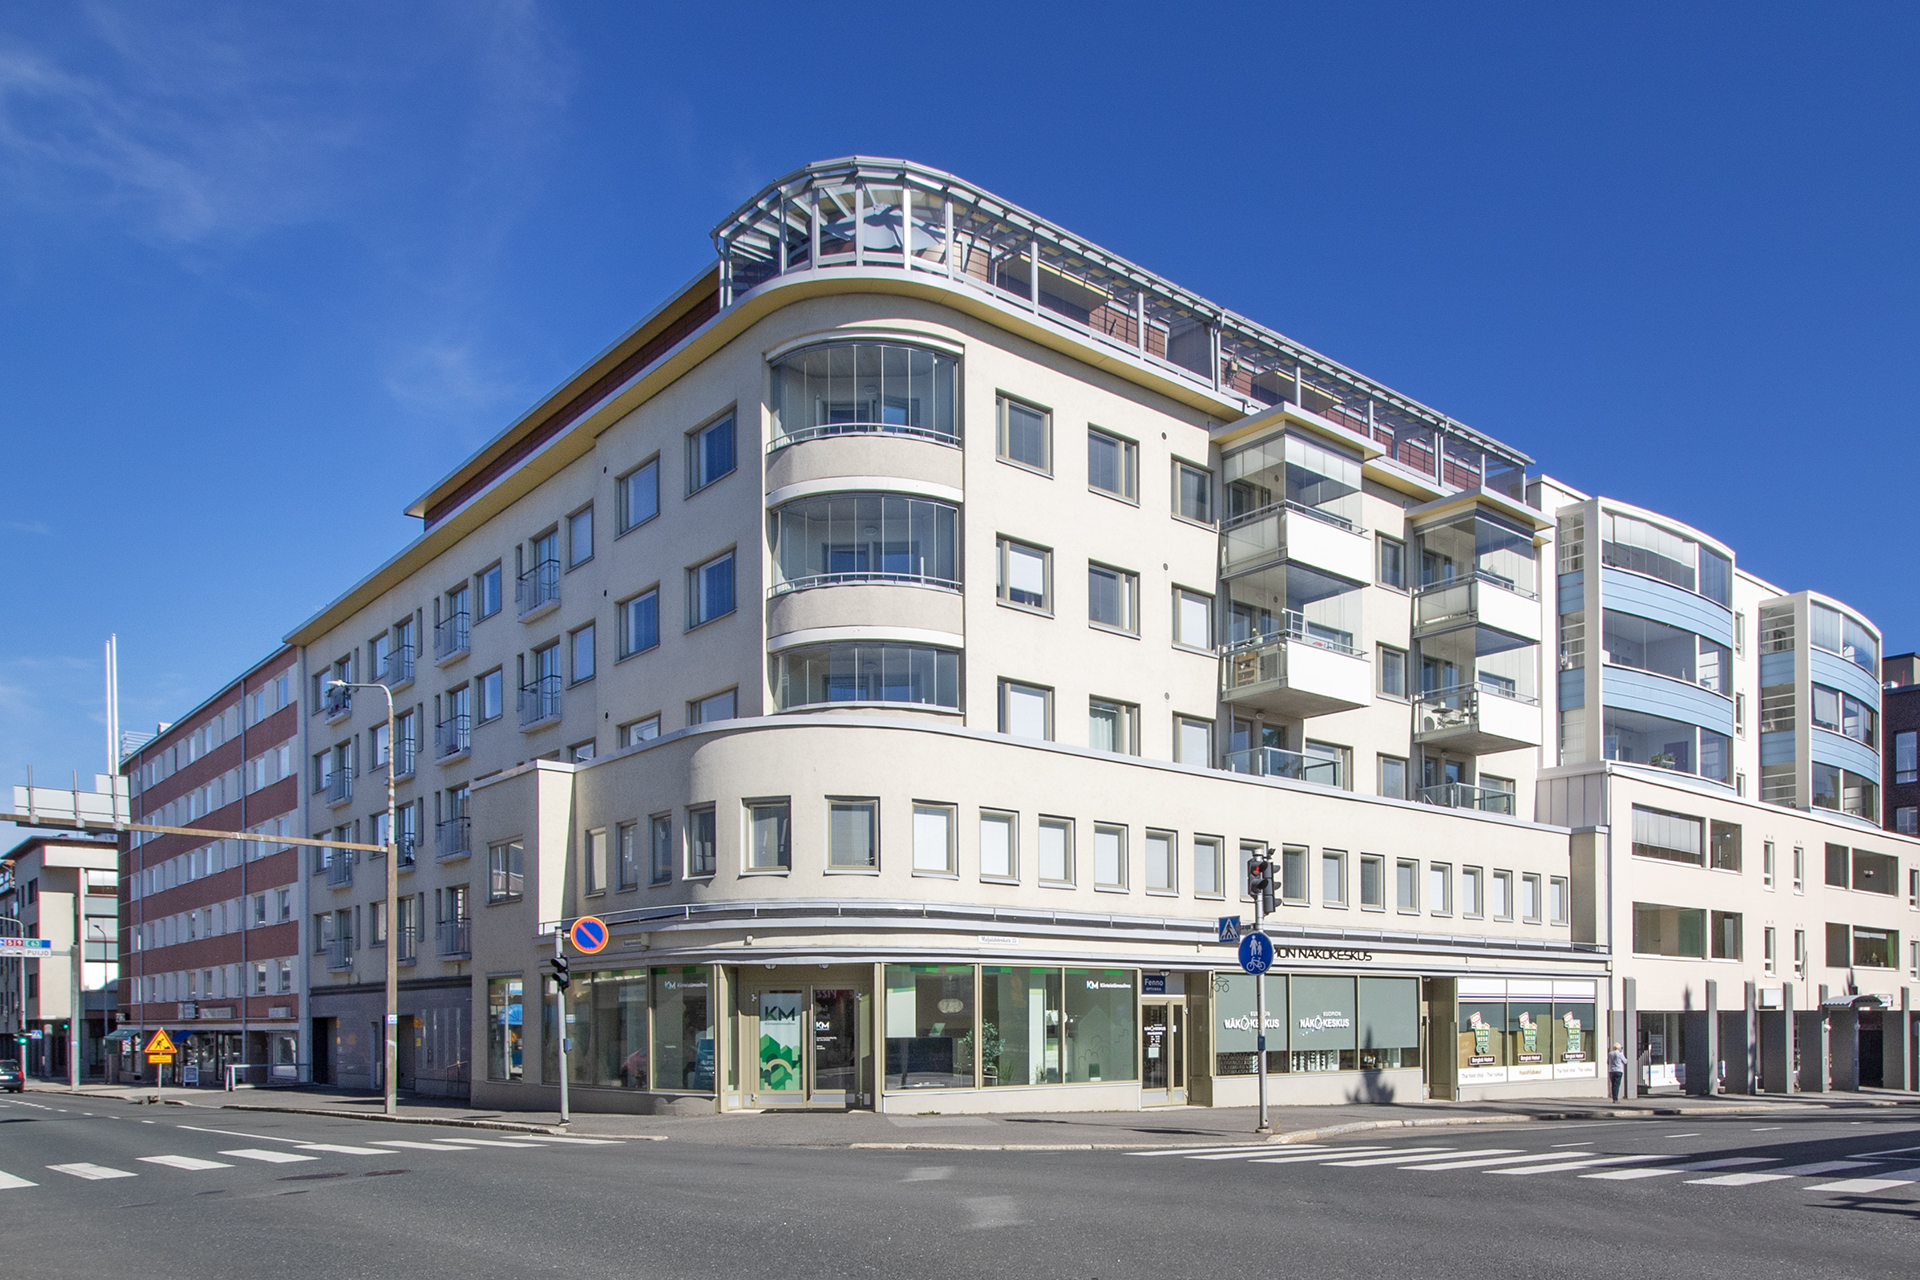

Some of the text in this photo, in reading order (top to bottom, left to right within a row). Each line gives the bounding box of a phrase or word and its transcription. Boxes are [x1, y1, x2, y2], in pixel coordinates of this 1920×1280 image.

[664, 981, 676, 989] KM
[1086, 980, 1099, 989] KM
[1144, 978, 1164, 986] Fenno
[765, 1006, 795, 1021] KM
[815, 1021, 829, 1029] KM
